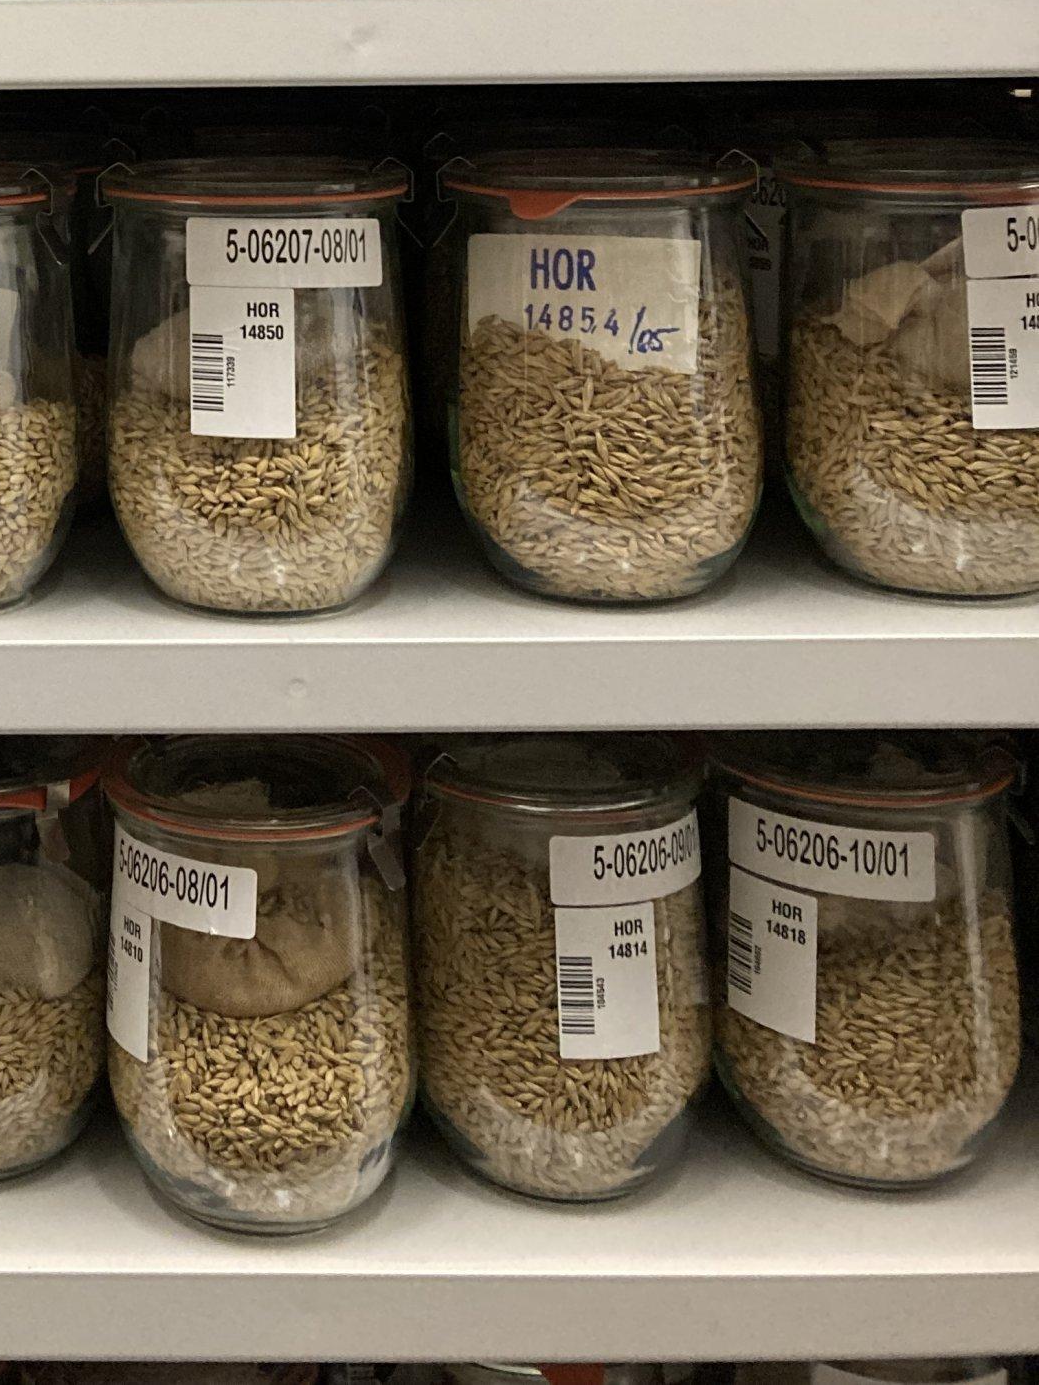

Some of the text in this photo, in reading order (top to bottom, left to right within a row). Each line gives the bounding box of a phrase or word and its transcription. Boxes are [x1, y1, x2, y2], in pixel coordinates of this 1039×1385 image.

[226, 226, 367, 266] 5-06207-08/01
[1007, 219, 1039, 253] 5-0
[530, 248, 596, 292] HOR
[246, 301, 280, 318] HOR
[239, 324, 284, 341] 14850
[756, 817, 910, 879] 5-06206-10/01
[119, 839, 229, 911] 5-06206-08/01
[771, 899, 802, 922] HOR
[123, 915, 141, 940] HOR
[614, 918, 644, 936] HOR
[765, 920, 807, 945] 14818
[608, 939, 648, 959] 14814
